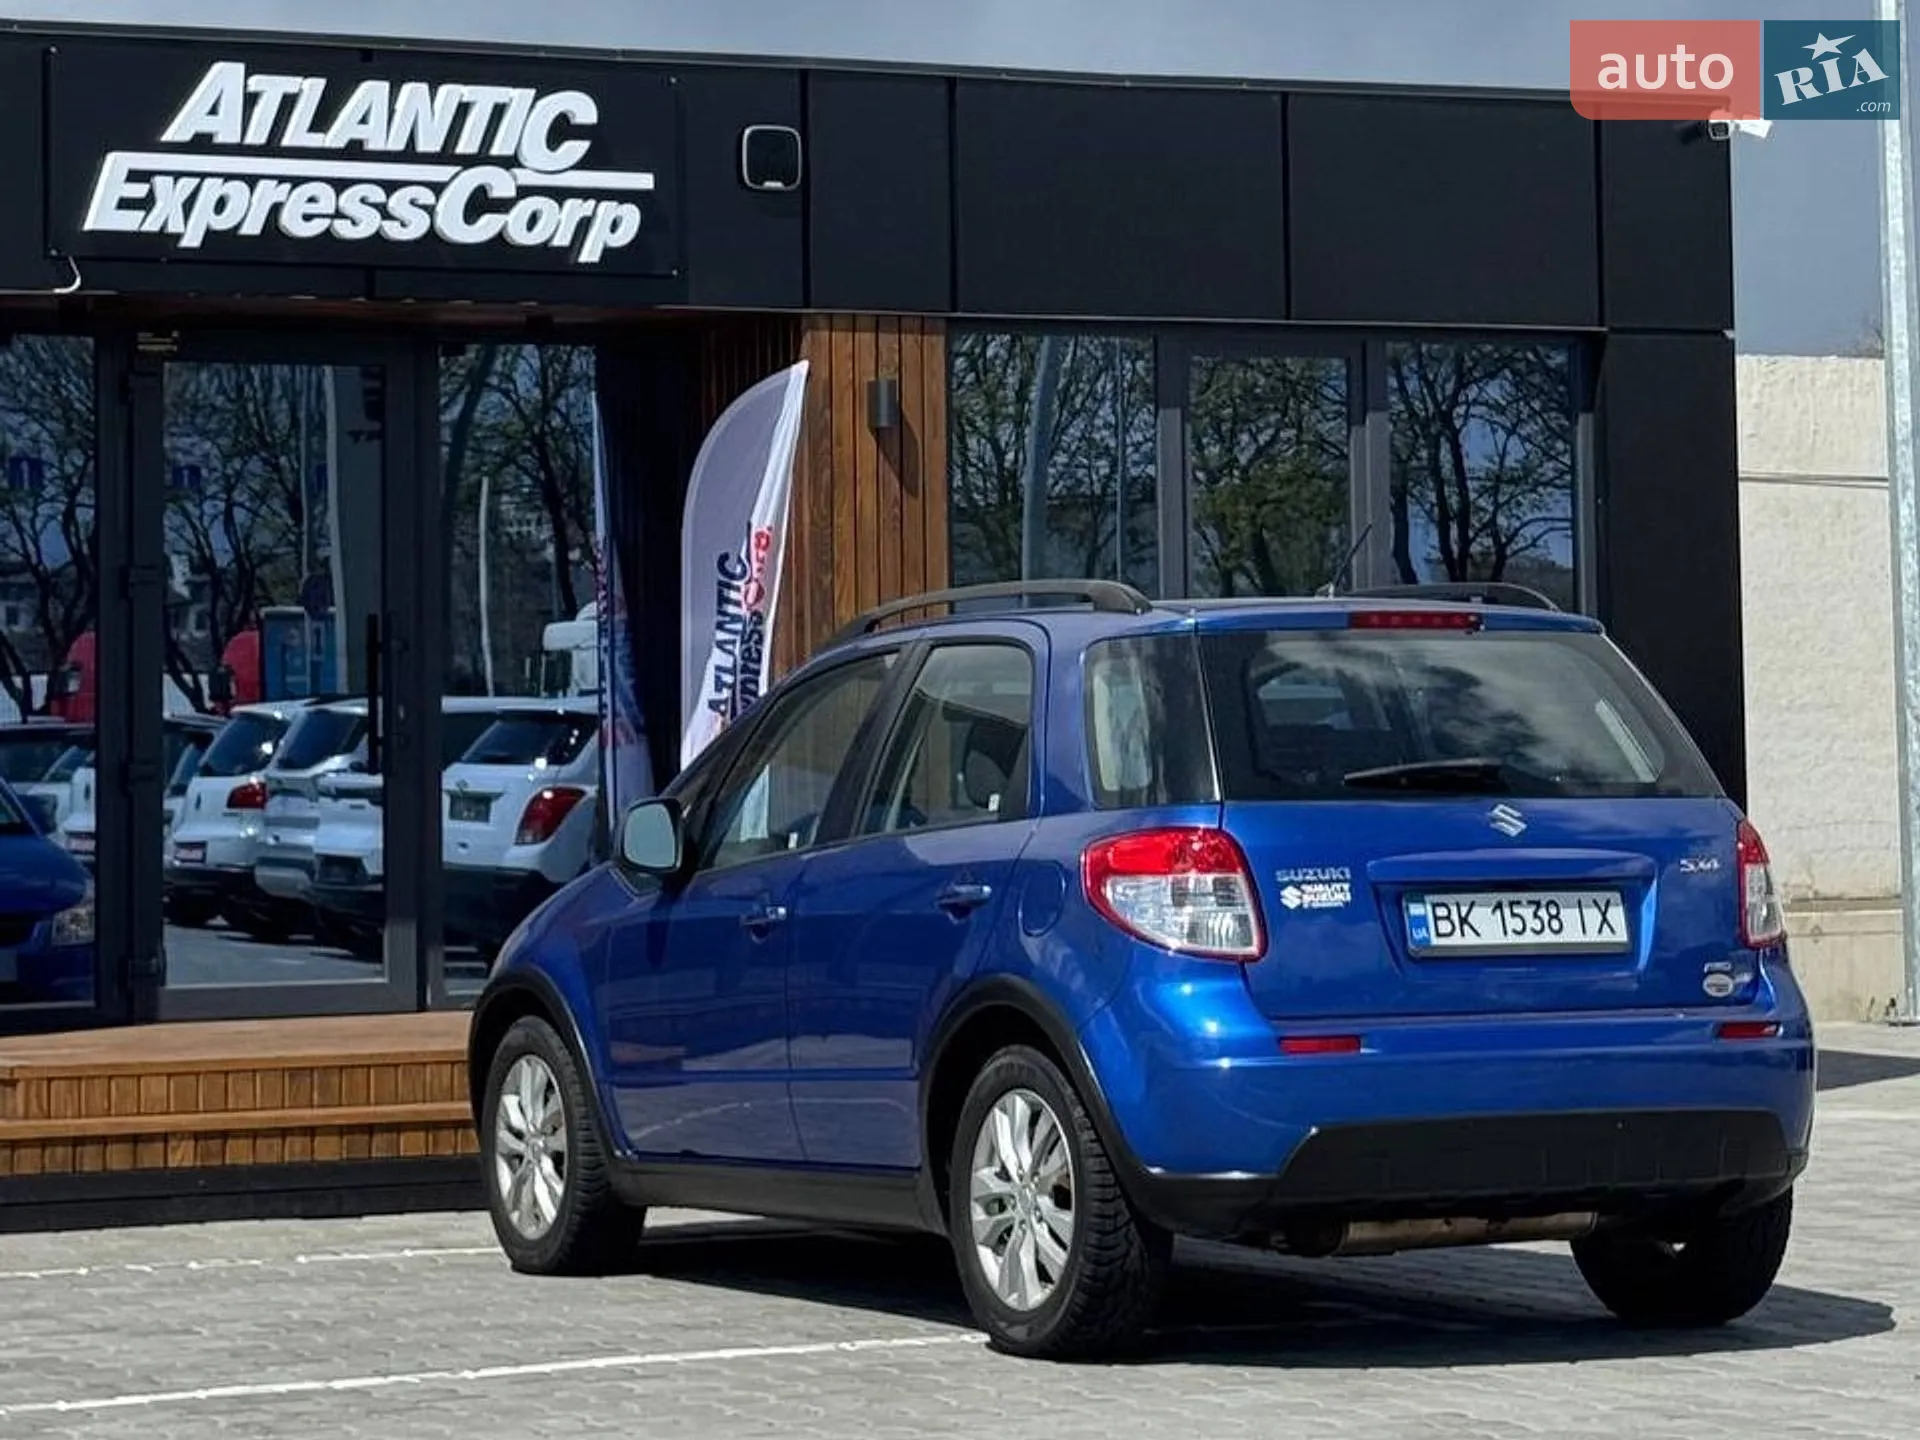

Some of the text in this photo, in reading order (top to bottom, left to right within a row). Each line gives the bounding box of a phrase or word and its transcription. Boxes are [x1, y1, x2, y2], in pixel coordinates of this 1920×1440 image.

[159, 61, 598, 171] ATLANTIC
[83, 152, 641, 263] ExpressCorp
[708, 552, 747, 714] ATLANTIC
[1276, 867, 1351, 881] SUZUKI
[1432, 898, 1616, 937] BK 1538 IX
